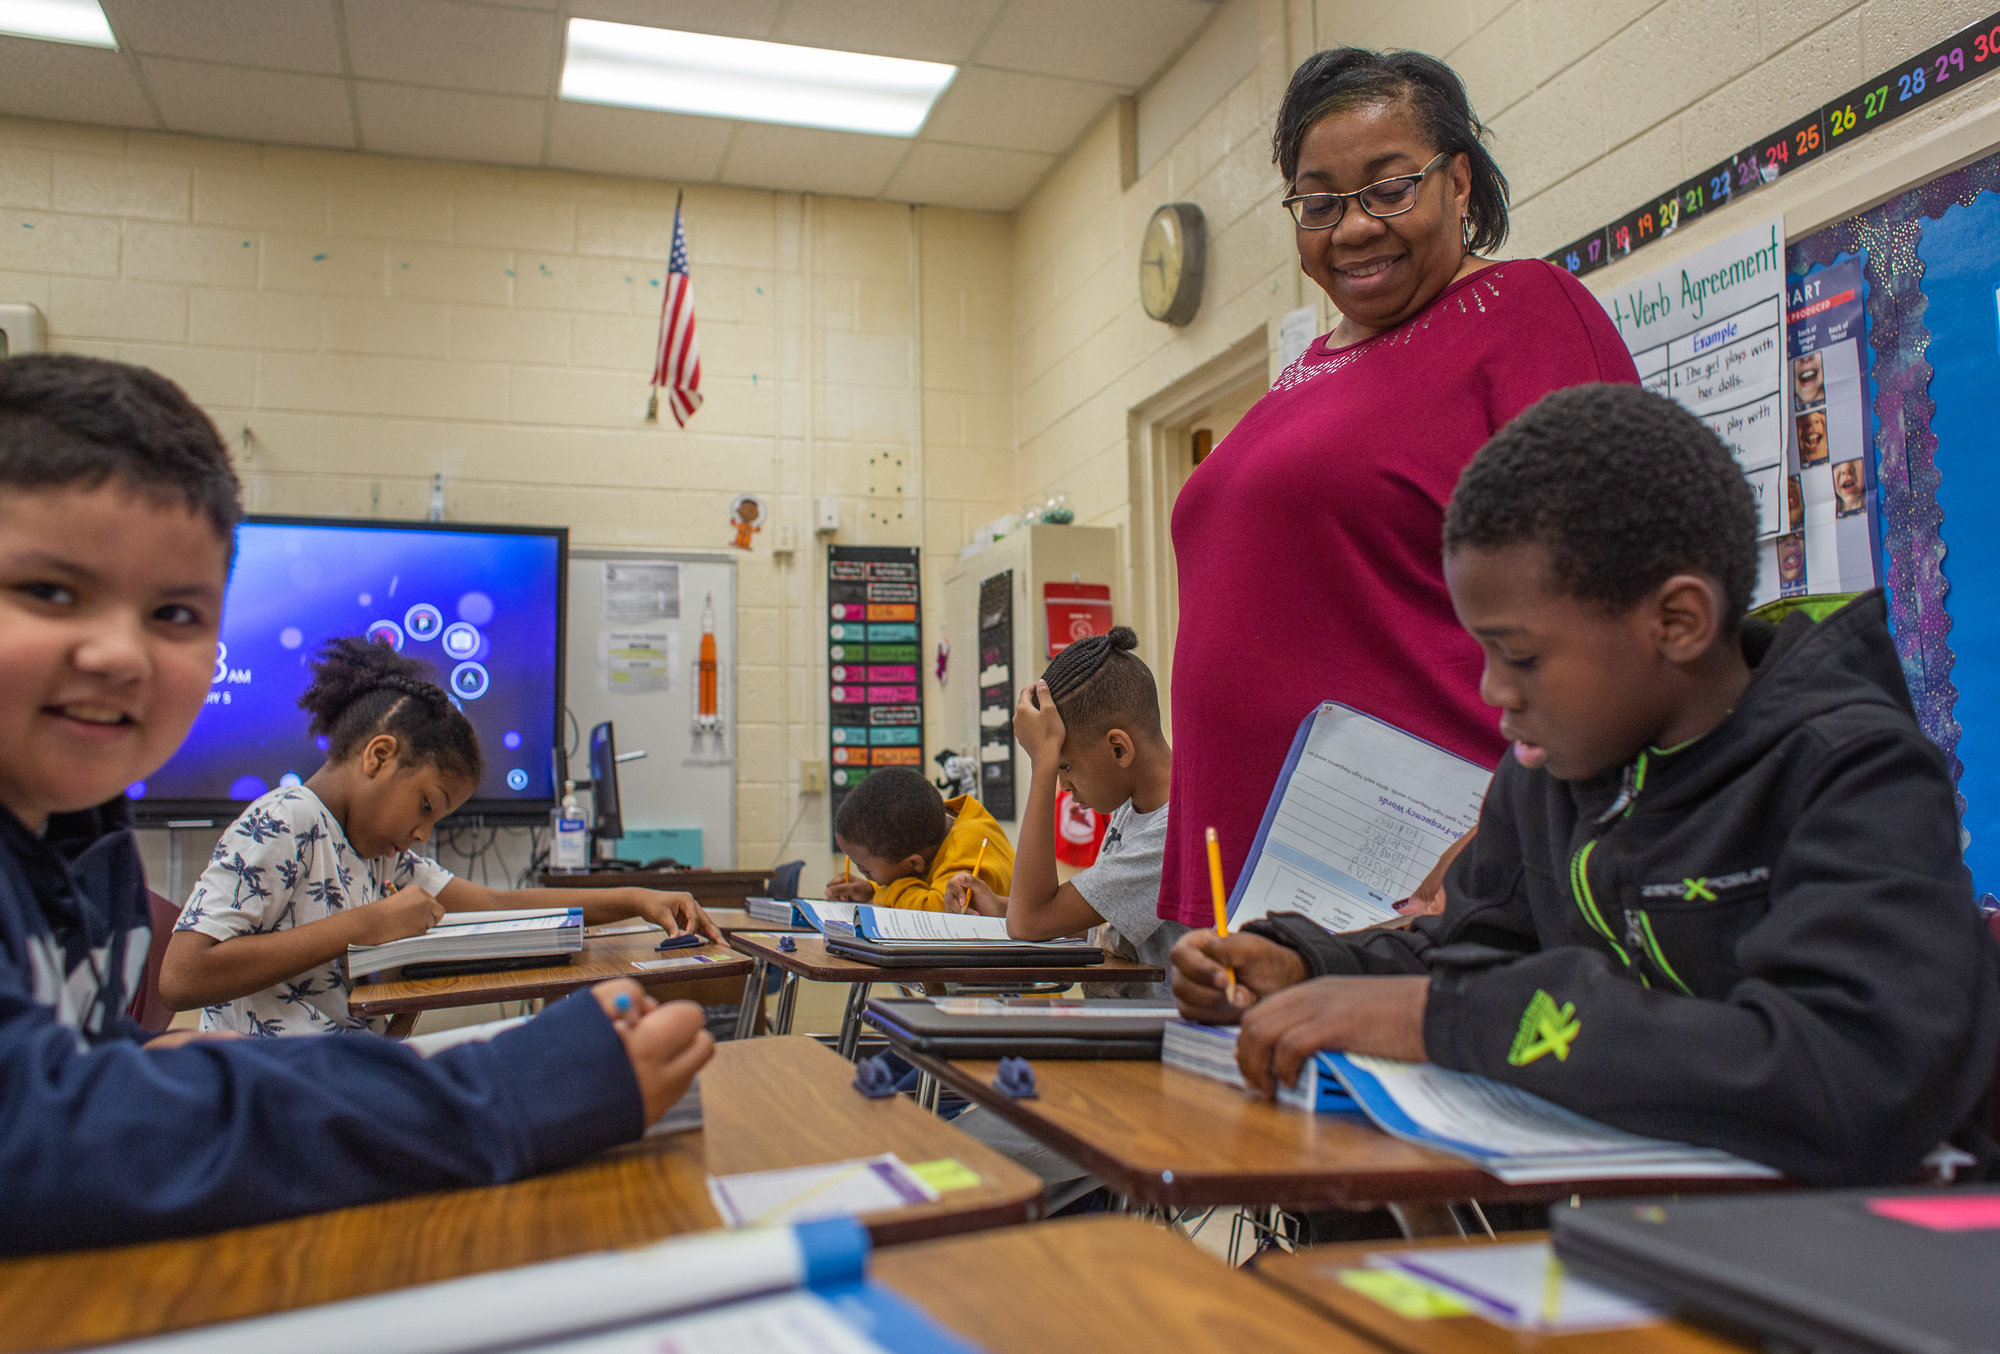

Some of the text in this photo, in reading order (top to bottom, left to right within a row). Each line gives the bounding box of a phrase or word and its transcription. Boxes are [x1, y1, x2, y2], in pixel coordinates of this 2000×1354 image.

[1565, 25, 2000, 272] 16 17 18 19 20 21 22 23 24 25 26 27 28 29 30
[1614, 224, 1779, 335] t-Verb Agreement
[1791, 299, 1831, 321] PRODUCED
[1693, 321, 1738, 354] Example
[1685, 365, 1700, 381] The
[1705, 355, 1720, 379] girl
[1725, 349, 1747, 370] plays
[1750, 337, 1773, 359] with
[1698, 385, 1713, 400] her
[1727, 415, 1744, 435] play
[1747, 404, 1770, 425] with
[227, 668, 251, 684] AM
[1376, 795, 1464, 840] gh-Frequency Words
